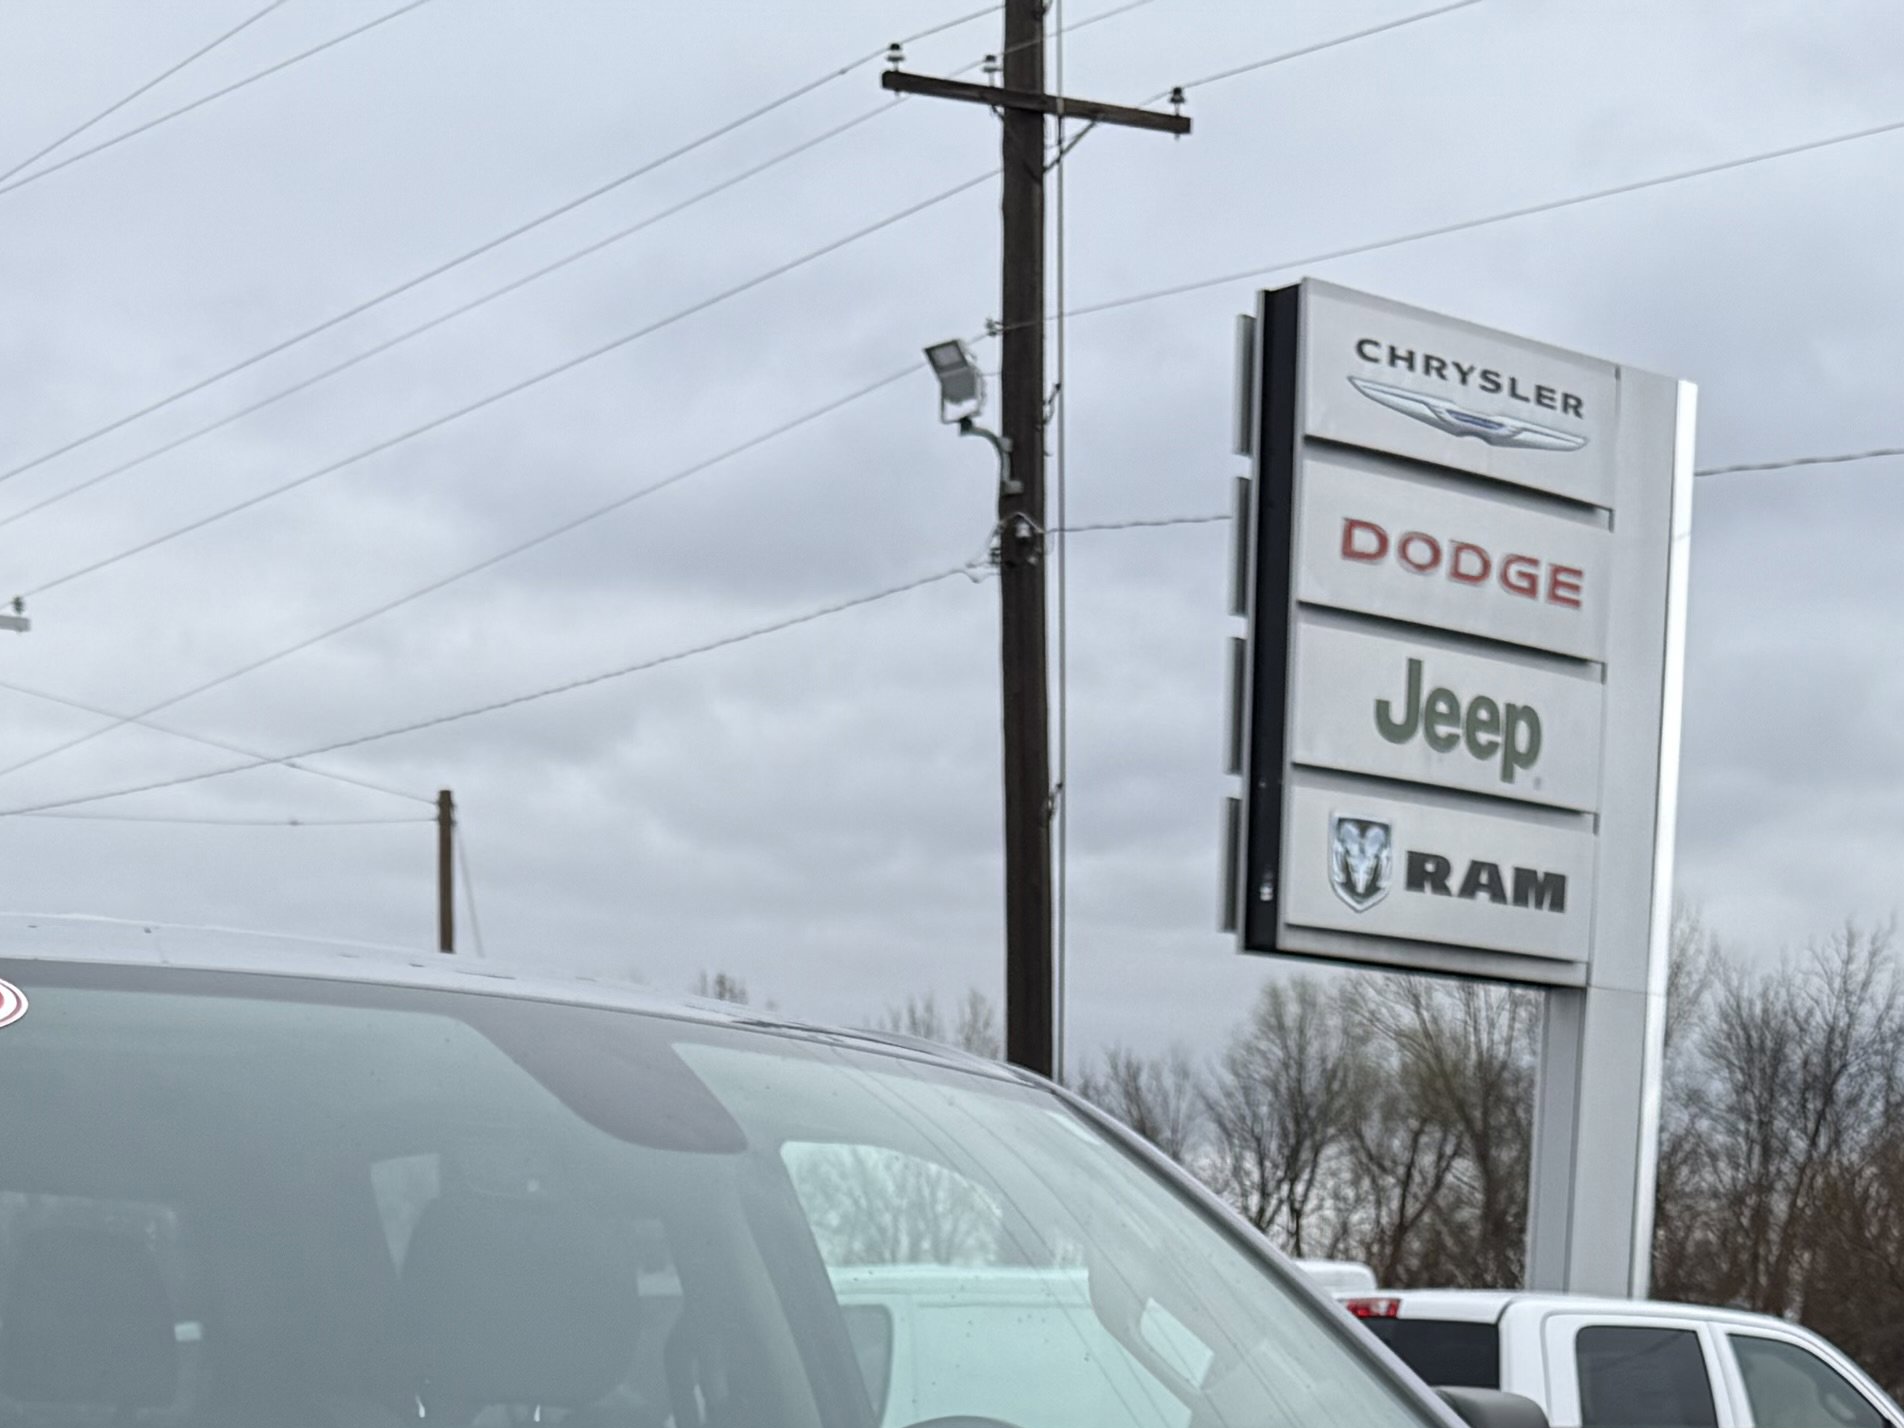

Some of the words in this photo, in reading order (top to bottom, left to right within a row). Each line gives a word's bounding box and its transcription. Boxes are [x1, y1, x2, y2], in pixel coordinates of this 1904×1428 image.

[1356, 338, 1585, 420] CHRYSLER
[1340, 516, 1584, 610] DODGE
[1374, 657, 1542, 784] Jeep
[1405, 850, 1568, 914] RAM
